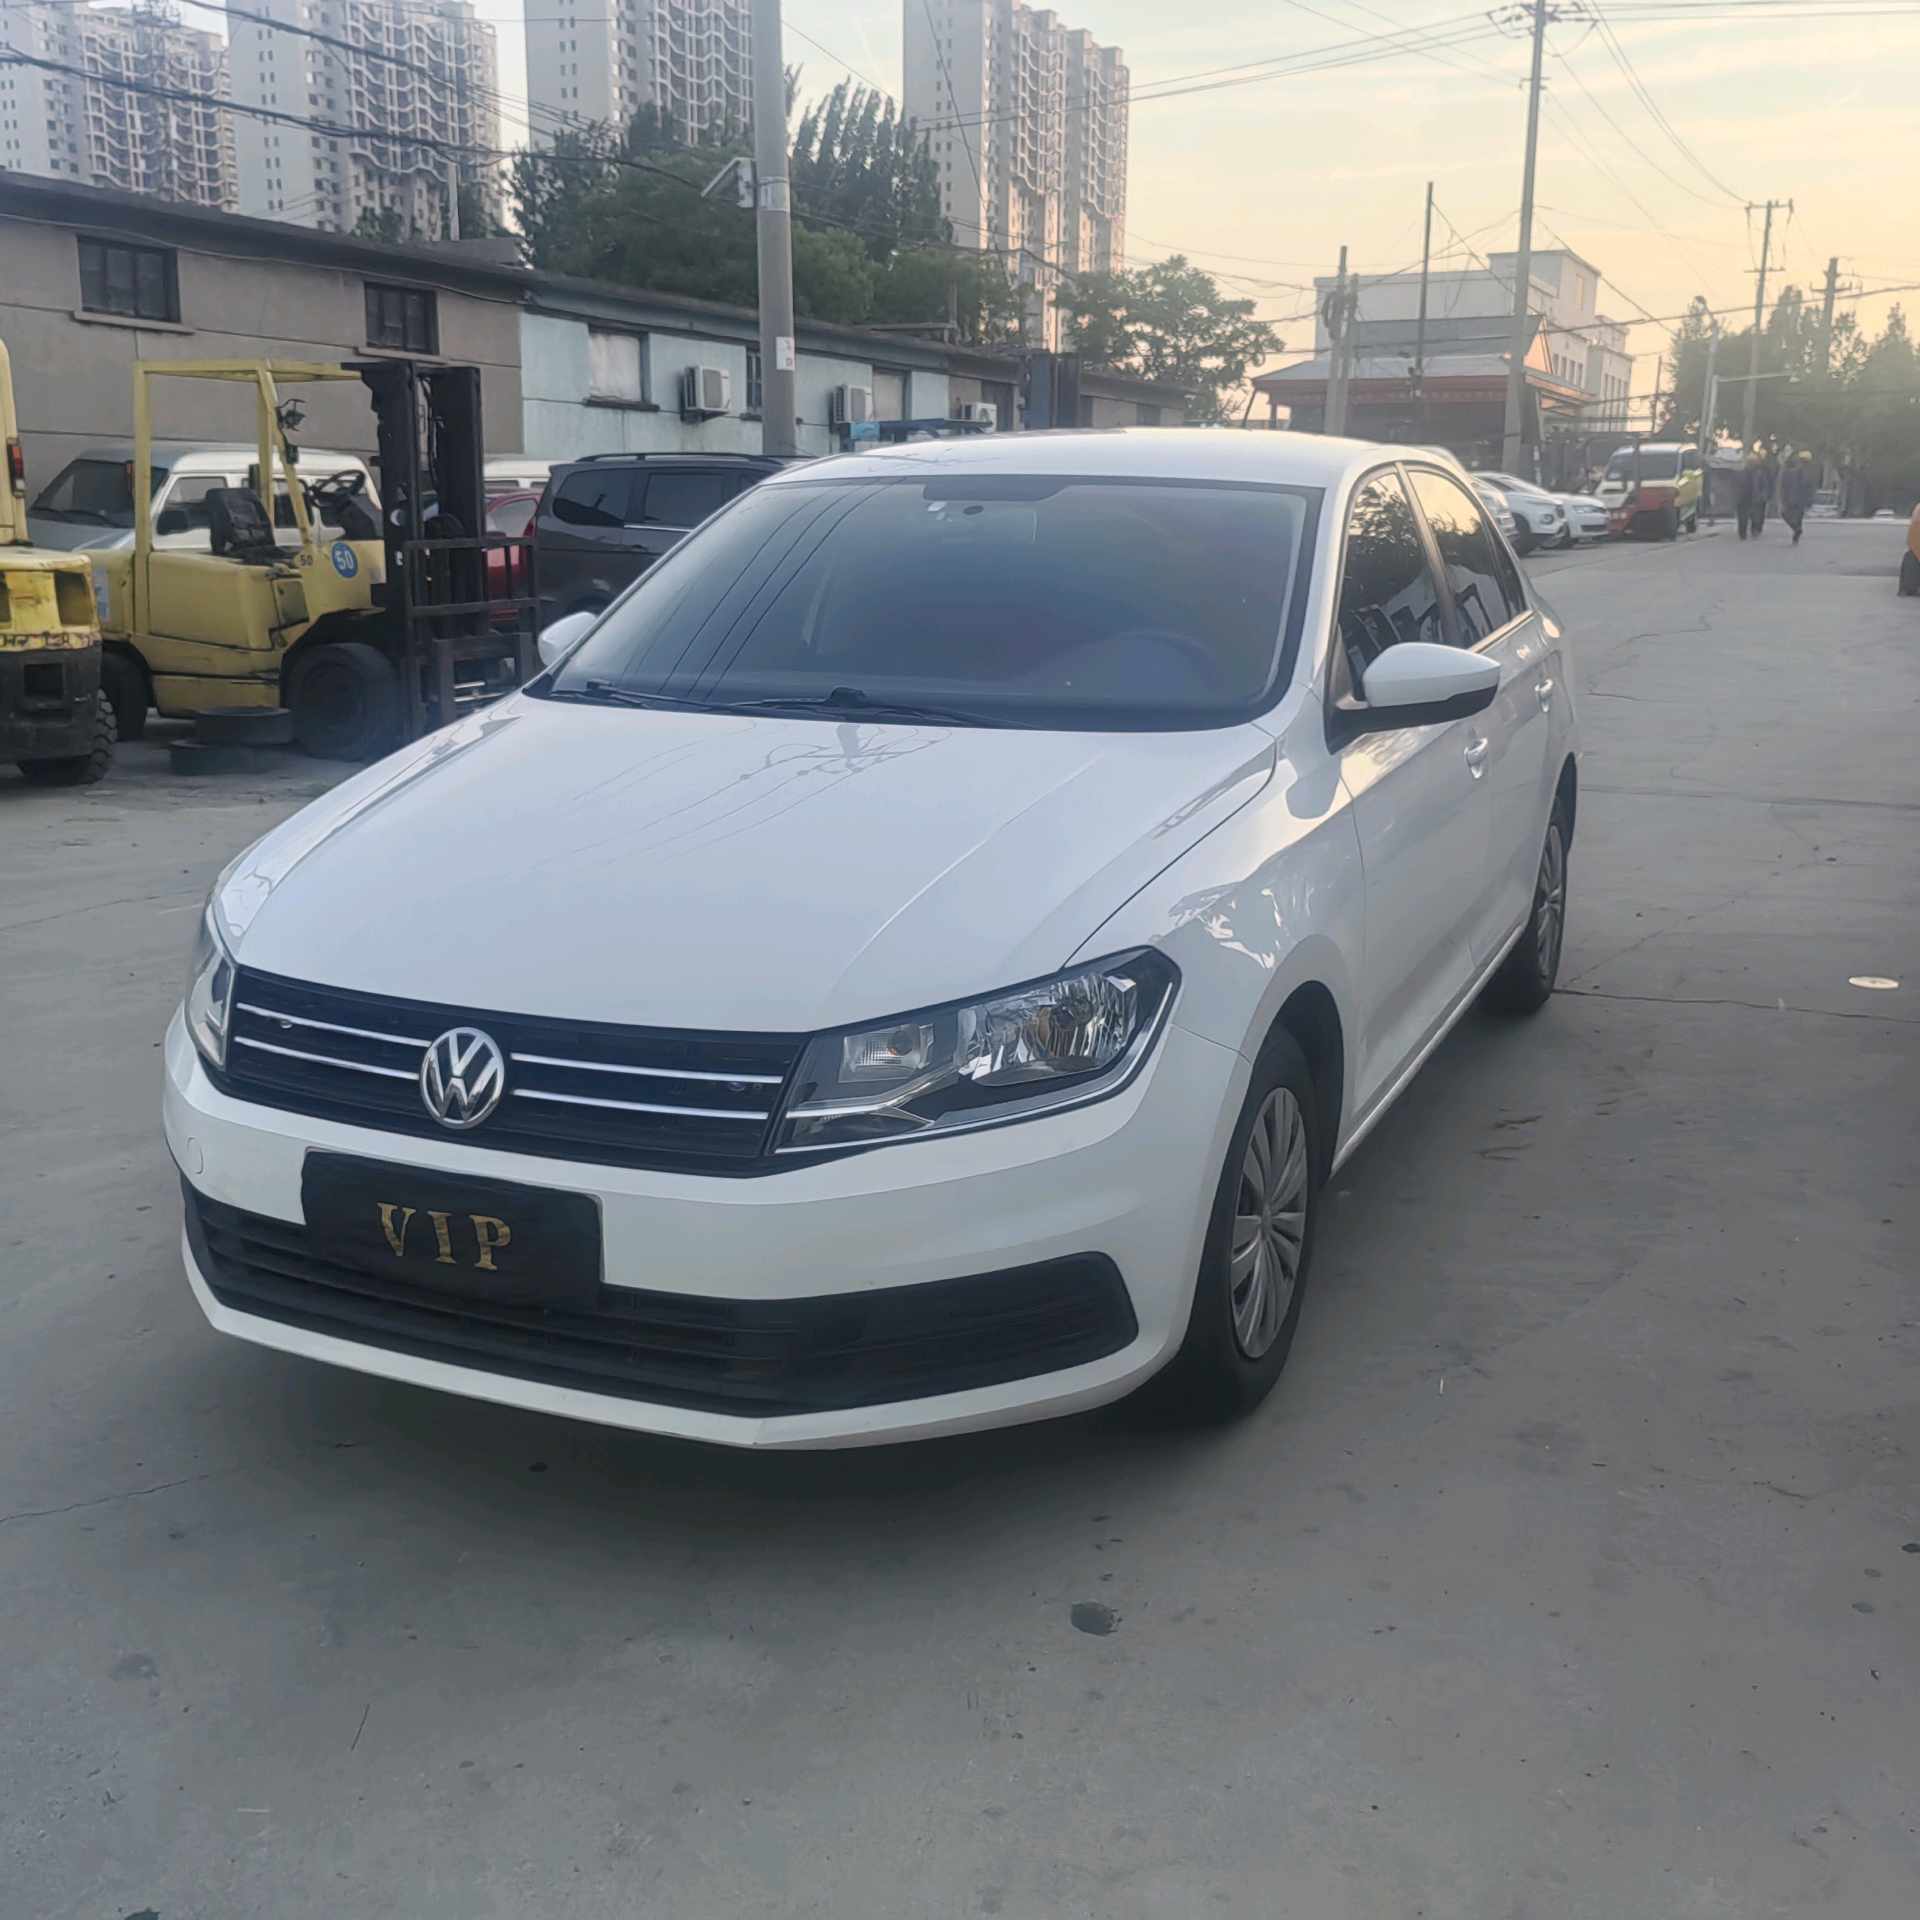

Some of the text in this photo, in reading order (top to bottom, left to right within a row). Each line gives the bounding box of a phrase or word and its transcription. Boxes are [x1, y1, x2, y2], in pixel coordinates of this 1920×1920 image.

[335, 550, 354, 570] 50
[422, 1028, 503, 1128] VW
[377, 1202, 511, 1270] VIP
